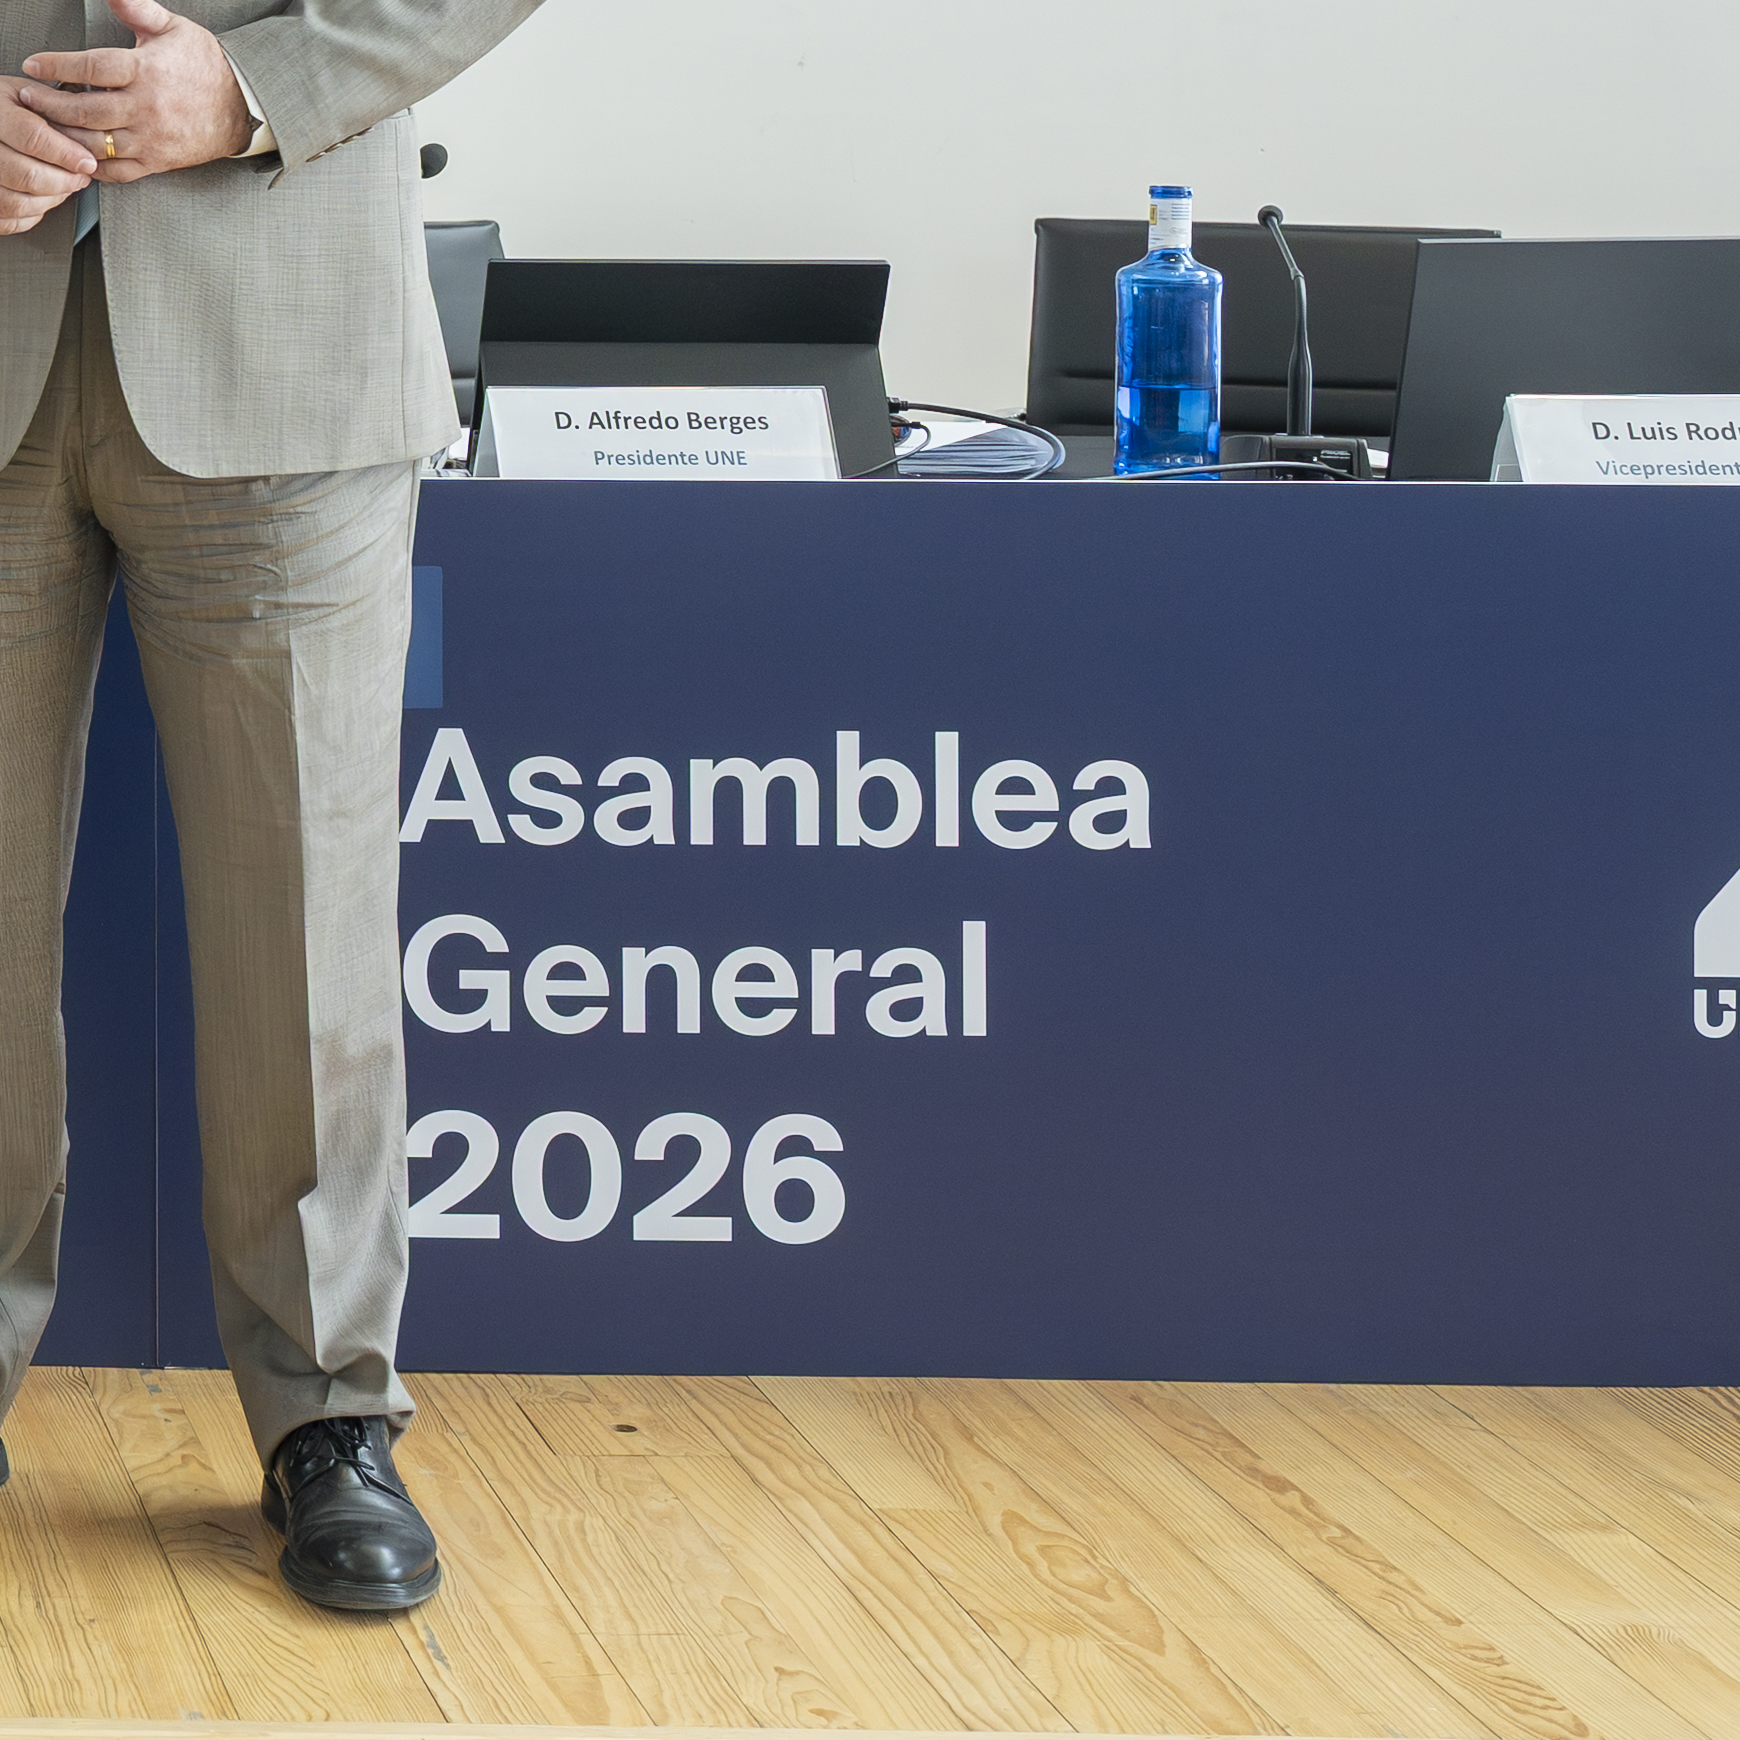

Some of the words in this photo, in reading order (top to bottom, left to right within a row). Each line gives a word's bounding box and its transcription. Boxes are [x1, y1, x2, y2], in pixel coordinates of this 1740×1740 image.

[554, 411, 580, 430] D.
[588, 410, 679, 430] Alfredo
[686, 411, 769, 435] Berges
[593, 449, 699, 466] Presidente
[705, 450, 748, 466] UNE
[1591, 421, 1619, 441] D.
[1627, 421, 1679, 441] Luis
[1685, 421, 1740, 441] Rod
[399, 727, 1152, 851] Asamblea
[402, 913, 987, 1039] General
[406, 1109, 846, 1245] 2026
